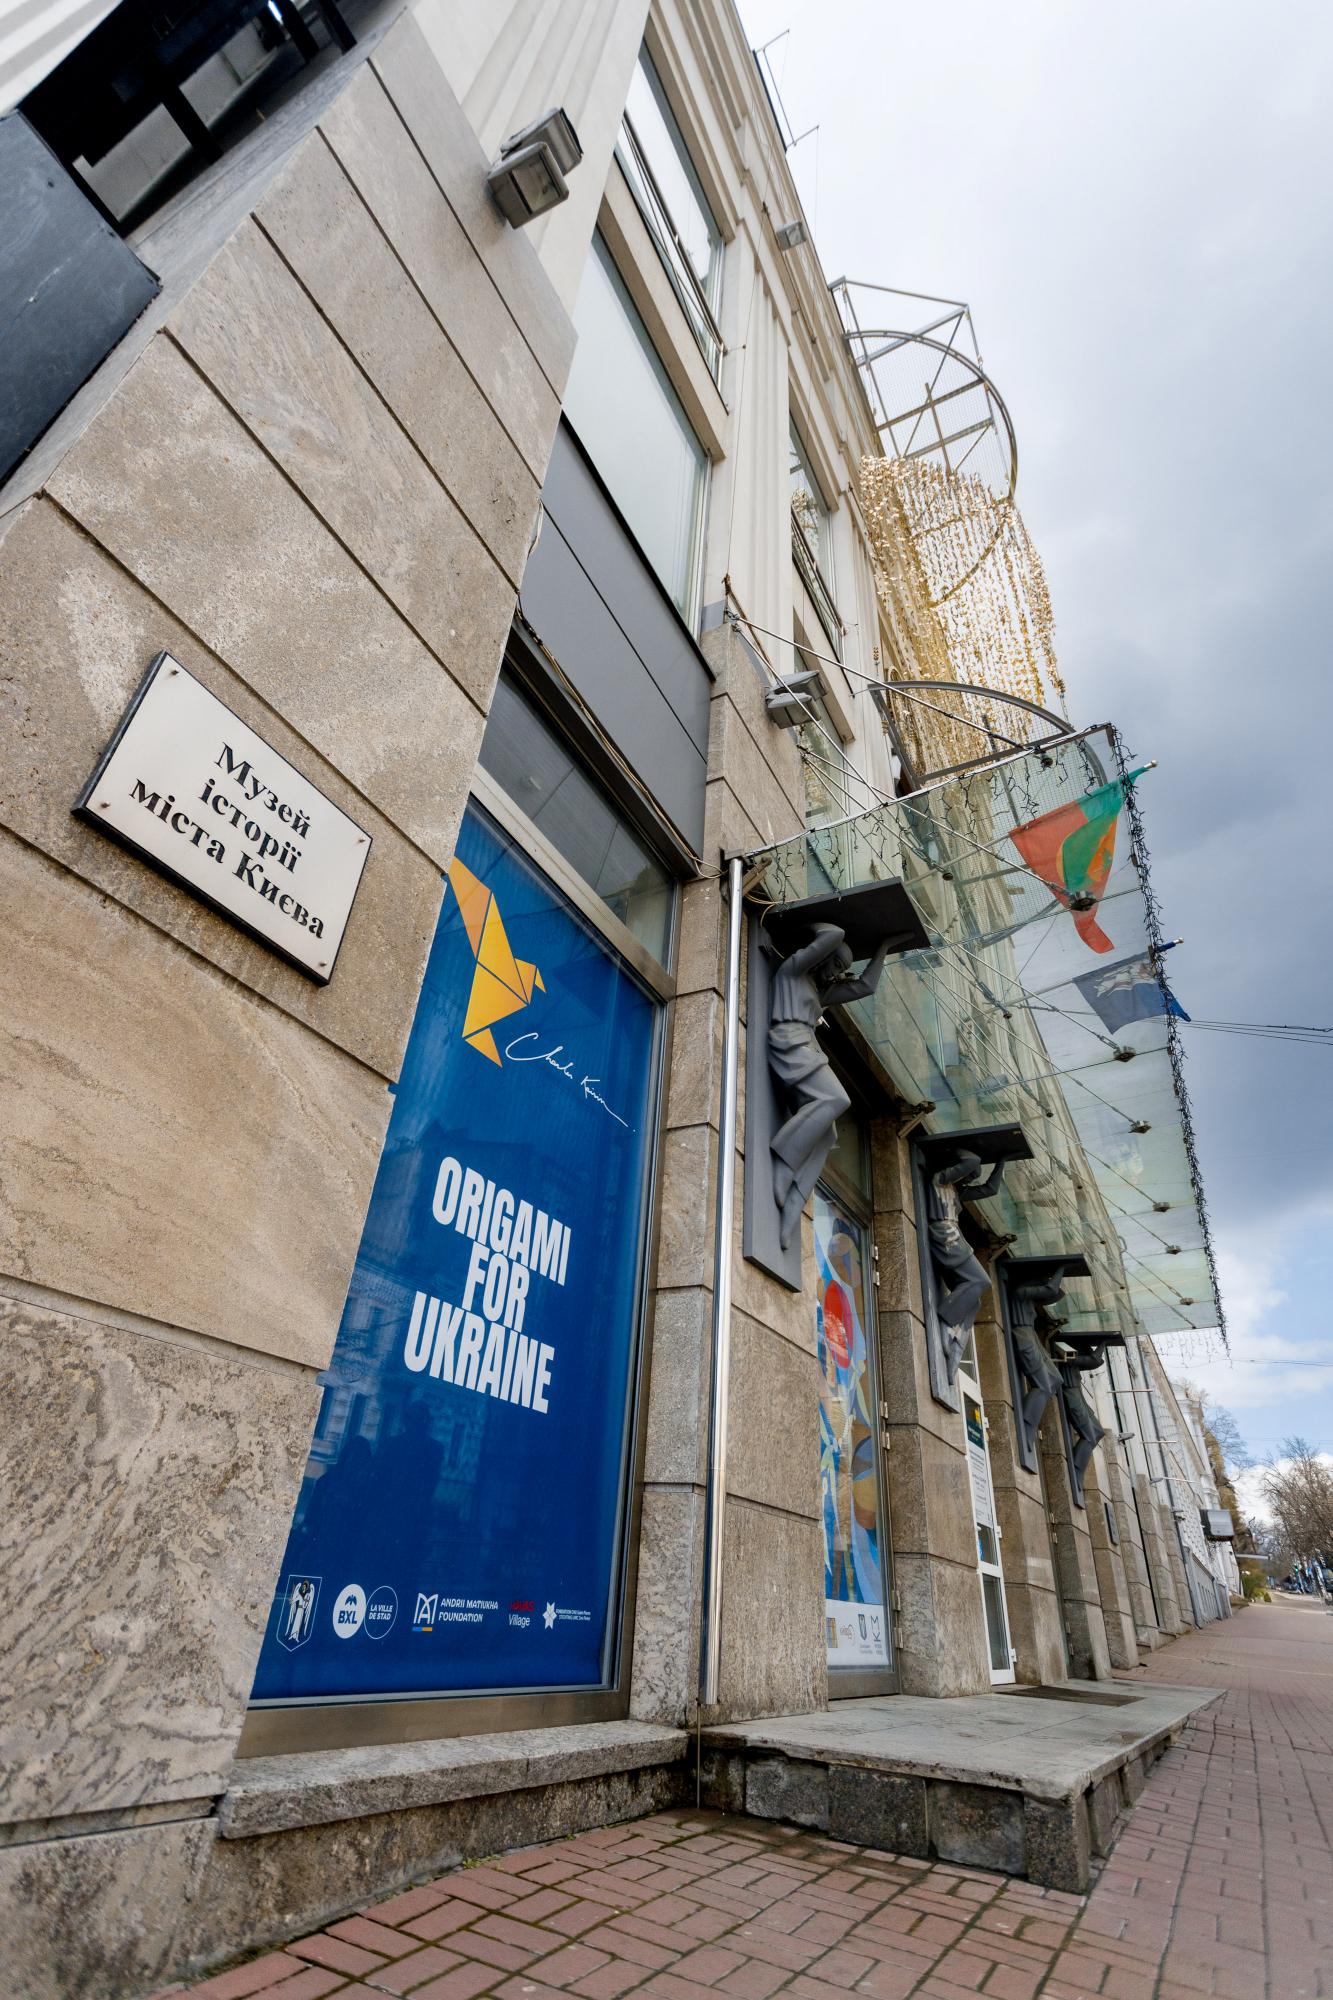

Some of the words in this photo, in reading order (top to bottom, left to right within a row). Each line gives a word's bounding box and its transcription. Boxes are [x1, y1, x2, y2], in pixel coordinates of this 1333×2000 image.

[214, 742, 311, 839] Музей
[198, 778, 302, 873] історії
[128, 778, 226, 864] міста
[232, 850, 325, 939] Києва
[432, 1156, 572, 1286] ORIGAMI
[461, 1241, 530, 1332] FOR
[404, 1291, 555, 1414] UKRAINE
[338, 1610, 358, 1624] BXL
[368, 1612, 376, 1620] DE
[377, 1612, 391, 1620] STAD
[370, 1604, 377, 1612] LA
[378, 1604, 393, 1612] VILLE
[438, 1611, 484, 1622] FOUNDATION
[440, 1598, 465, 1608] ANDRII
[508, 1613, 530, 1629] Village
